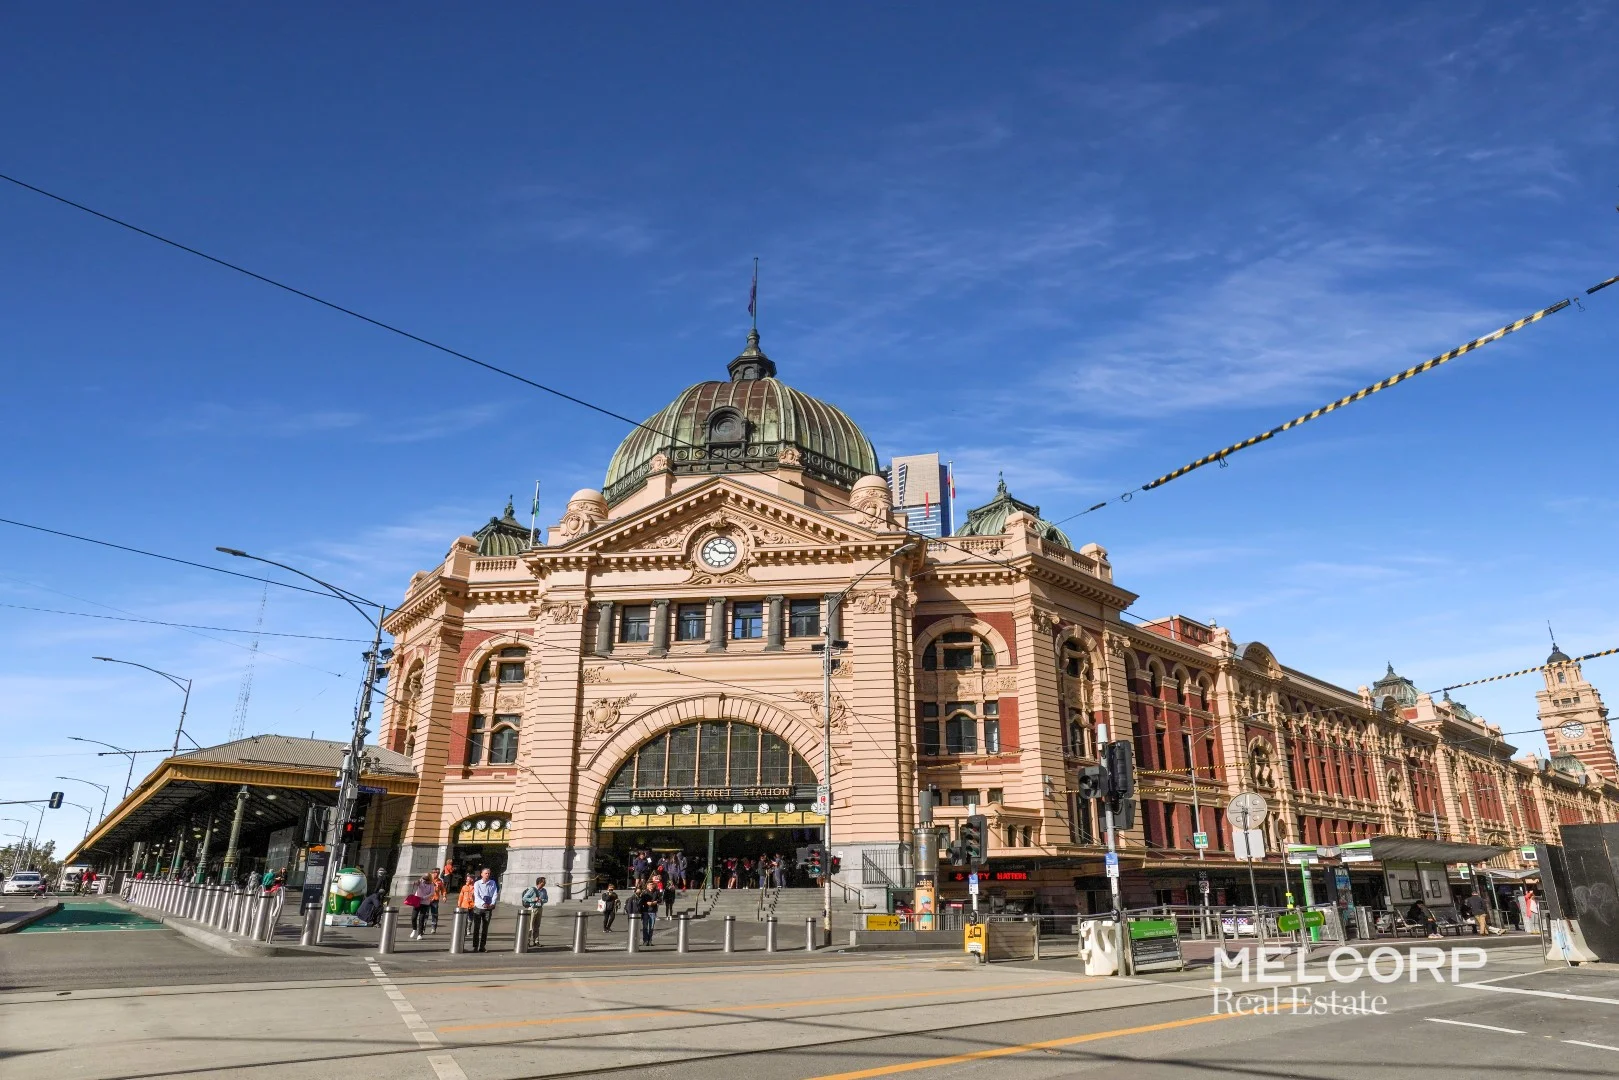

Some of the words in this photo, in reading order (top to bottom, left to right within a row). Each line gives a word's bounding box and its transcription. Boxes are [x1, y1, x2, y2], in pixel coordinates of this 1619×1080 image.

[632, 790, 681, 798] FLINDERS
[694, 788, 732, 797] STREET
[743, 788, 790, 796] STATION
[996, 872, 1027, 880] HATTERS
